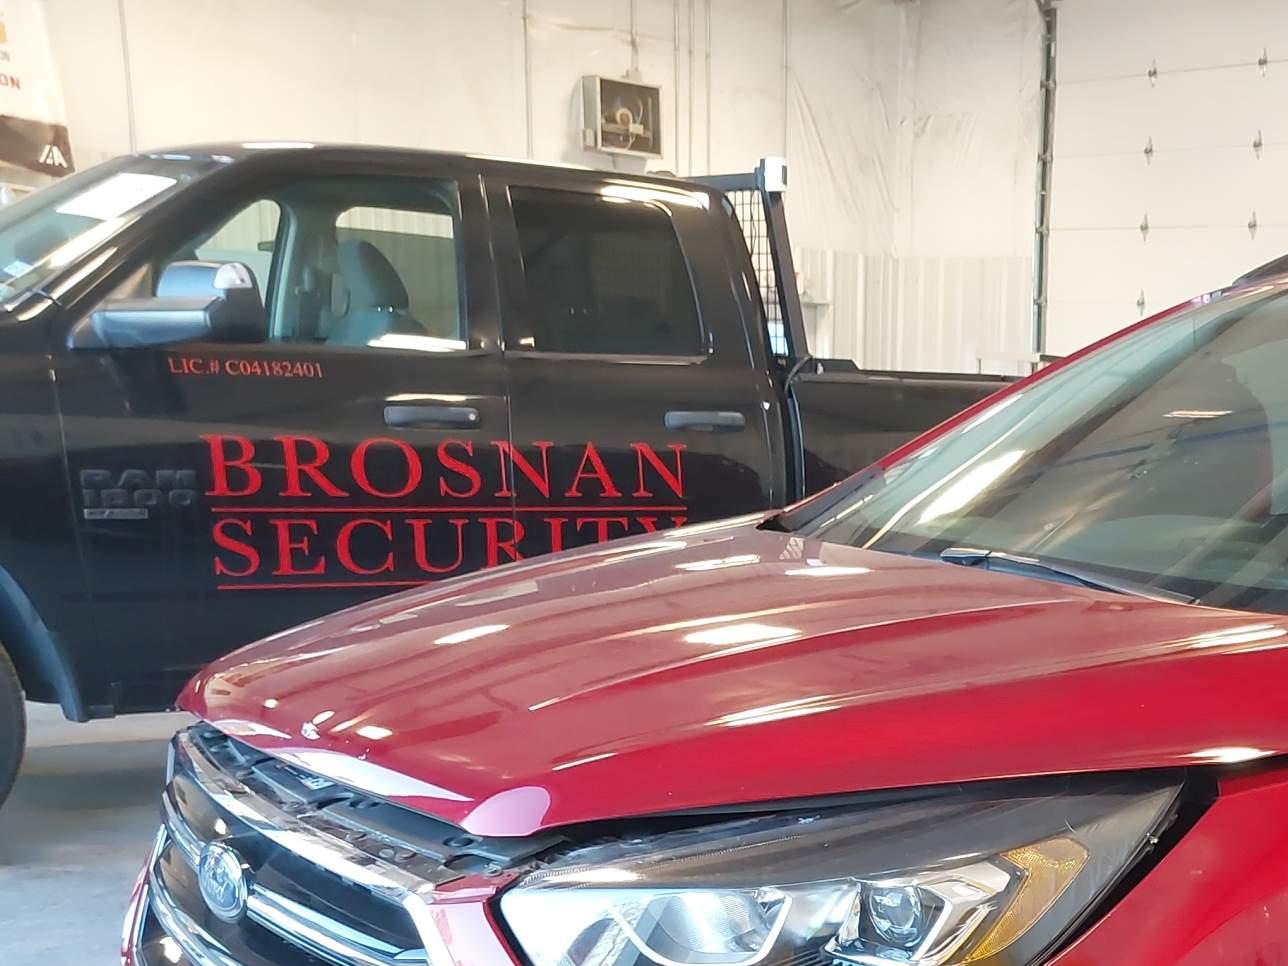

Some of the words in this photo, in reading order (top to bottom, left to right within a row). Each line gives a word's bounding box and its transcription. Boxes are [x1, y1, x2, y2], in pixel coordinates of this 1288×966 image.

[168, 356, 220, 375] LIC.#
[225, 359, 323, 378] C04182401
[201, 434, 687, 499] BROSNAN
[213, 516, 688, 577] SECURIT
